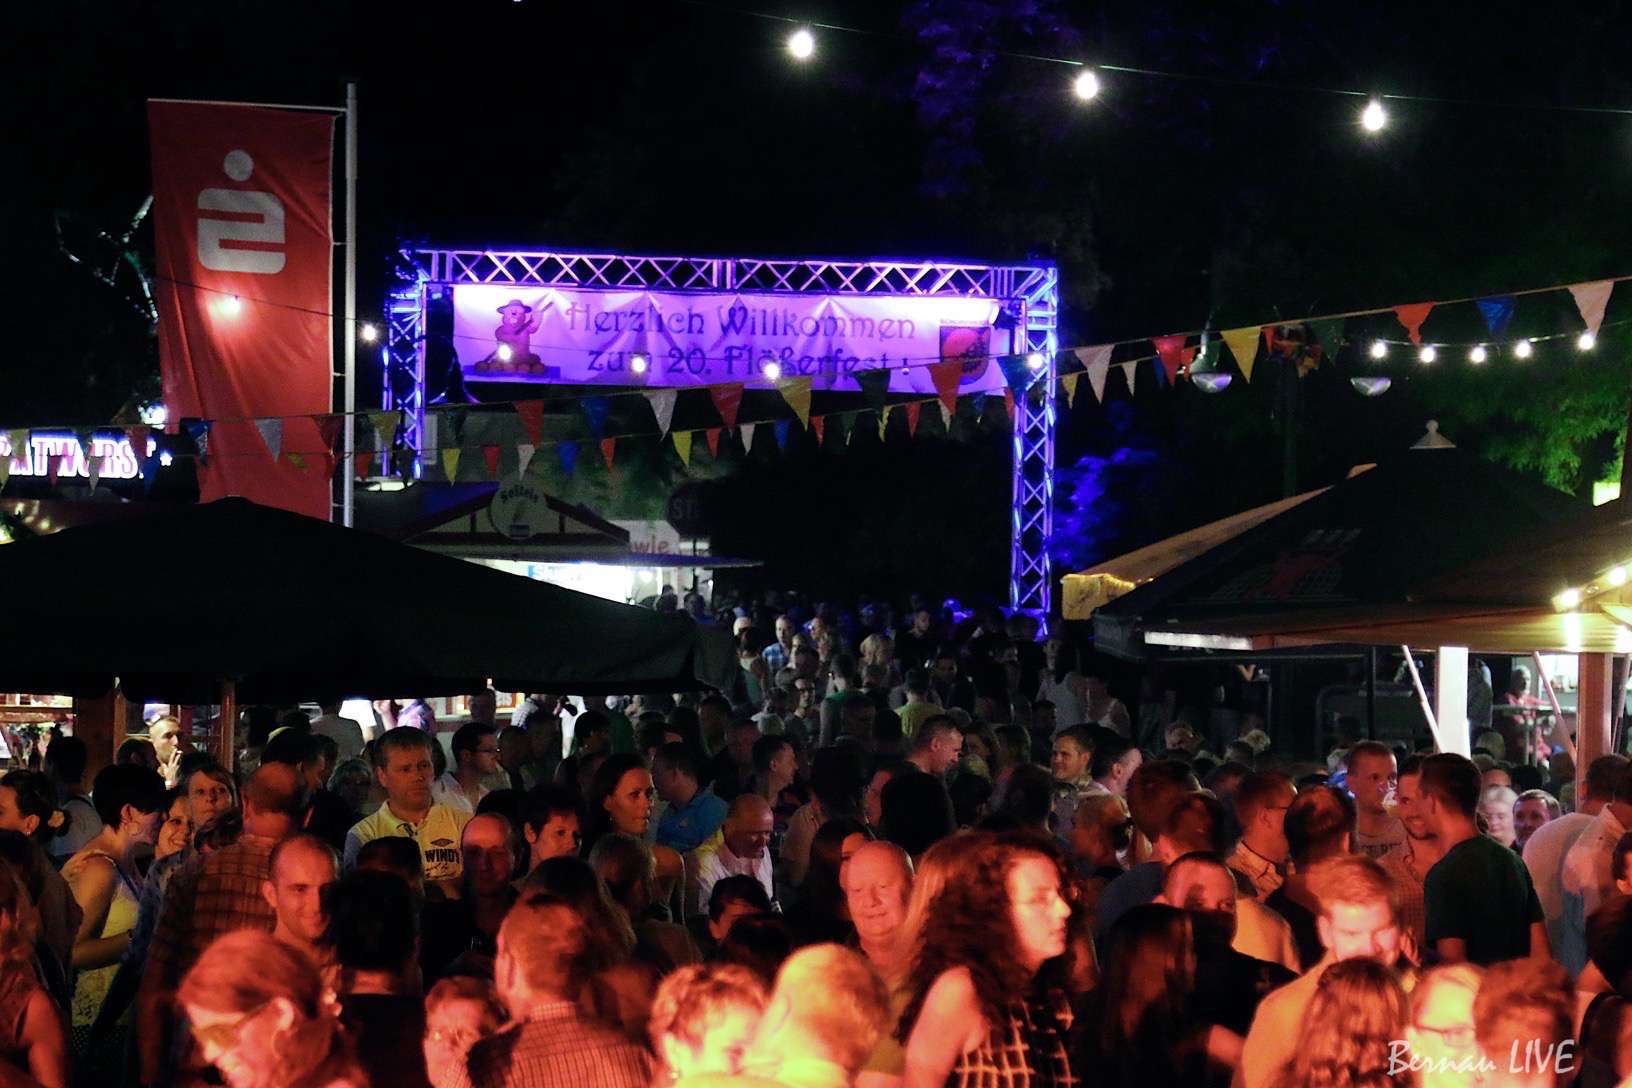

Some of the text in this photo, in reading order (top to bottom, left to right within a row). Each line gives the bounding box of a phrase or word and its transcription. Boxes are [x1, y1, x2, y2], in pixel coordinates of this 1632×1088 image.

[566, 302, 915, 341] Herzlich Willkommen
[666, 344, 711, 375] 20.
